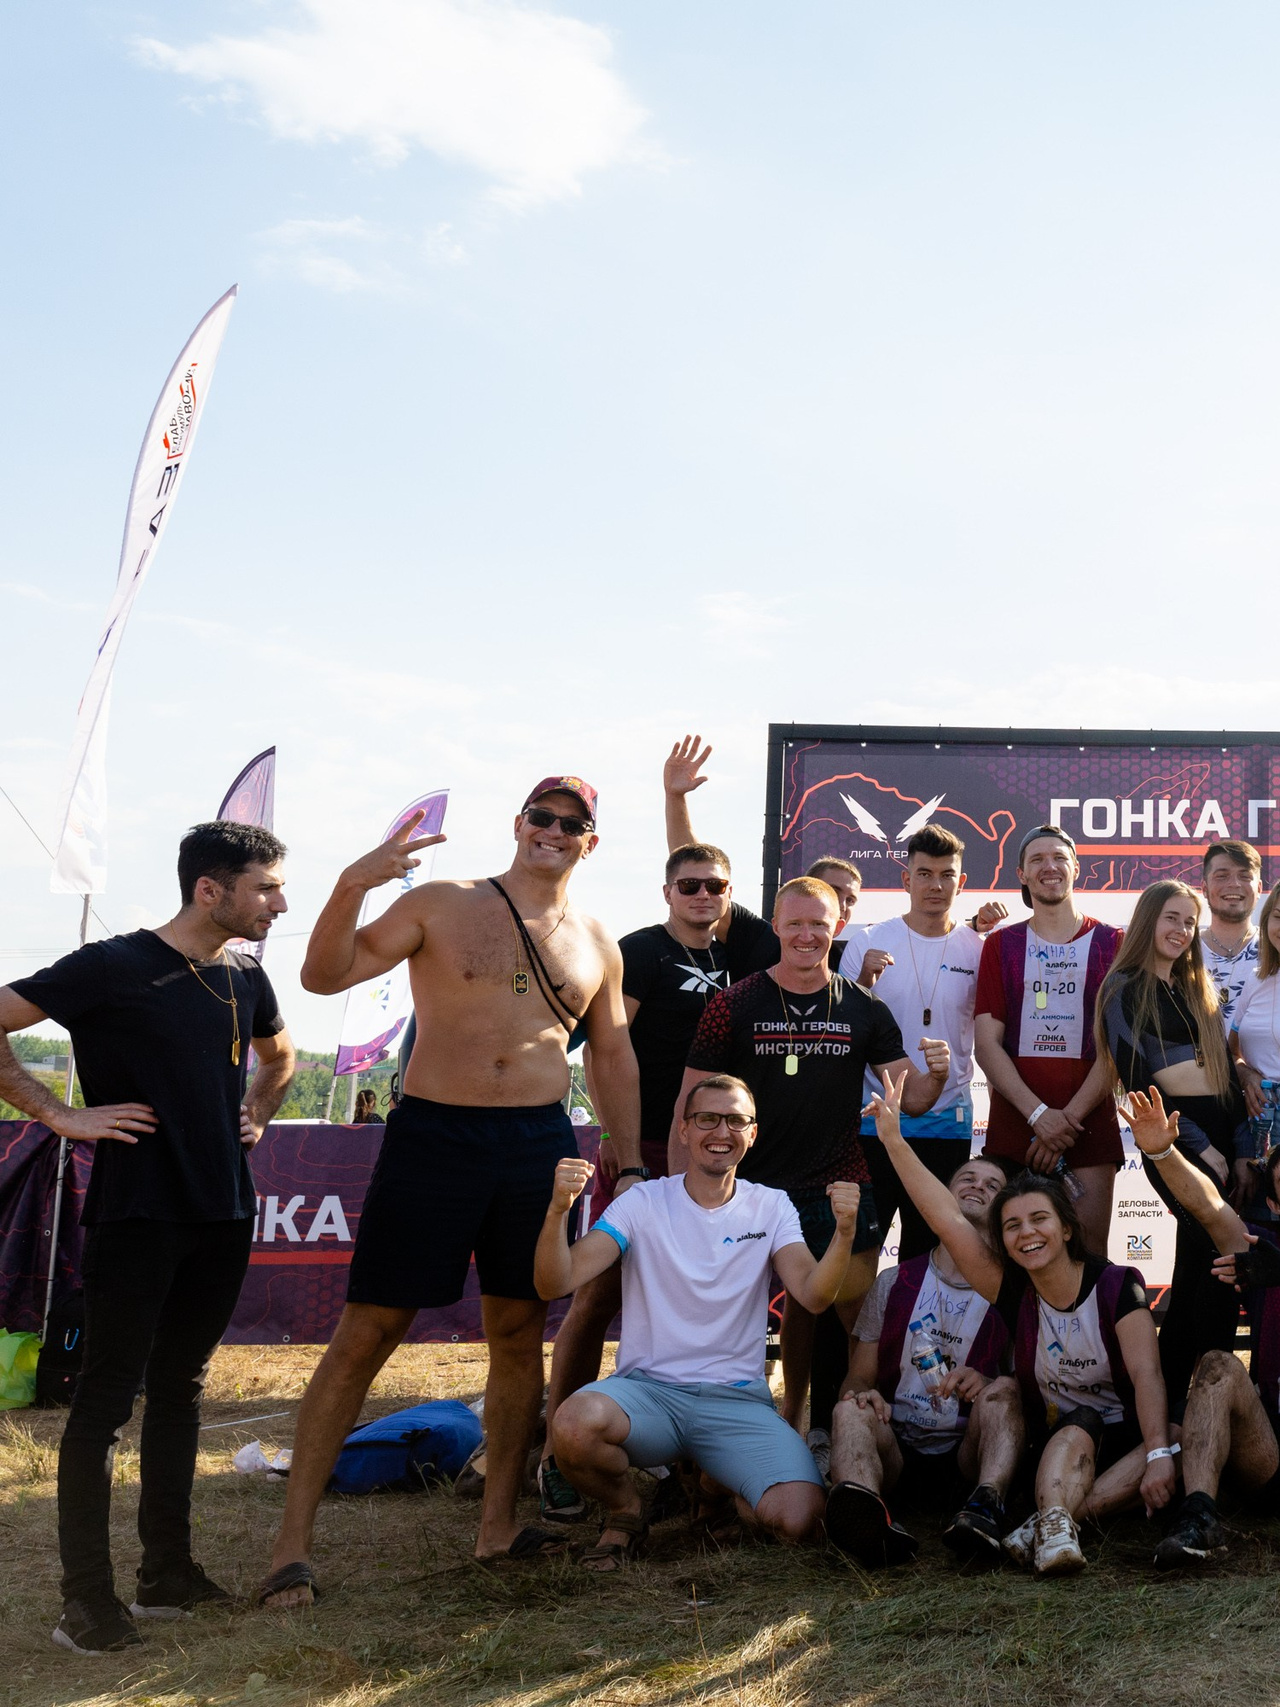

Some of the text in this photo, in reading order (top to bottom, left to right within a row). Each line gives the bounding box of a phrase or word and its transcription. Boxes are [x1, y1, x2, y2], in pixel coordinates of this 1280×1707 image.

[1049, 798, 1231, 838] ГОНКА
[849, 850, 909, 859] ЛИГА ГЕР
[1045, 961, 1078, 970] алабуга
[949, 966, 975, 976] alabuga
[1032, 980, 1076, 995] 01-20
[754, 1021, 852, 1034] ГОНКА ГЕРОЕВ
[1036, 1034, 1066, 1042] ГОНКА
[754, 1042, 851, 1057] ИНСТРУКТОР
[1033, 1044, 1067, 1052] ГЕРОЕВ
[1117, 1200, 1160, 1209] ДЕЛОВЫЕ
[1117, 1210, 1163, 1219] ЗАПЧАСТИ
[736, 1231, 767, 1243] alabuga
[1058, 1357, 1098, 1370] алабуга
